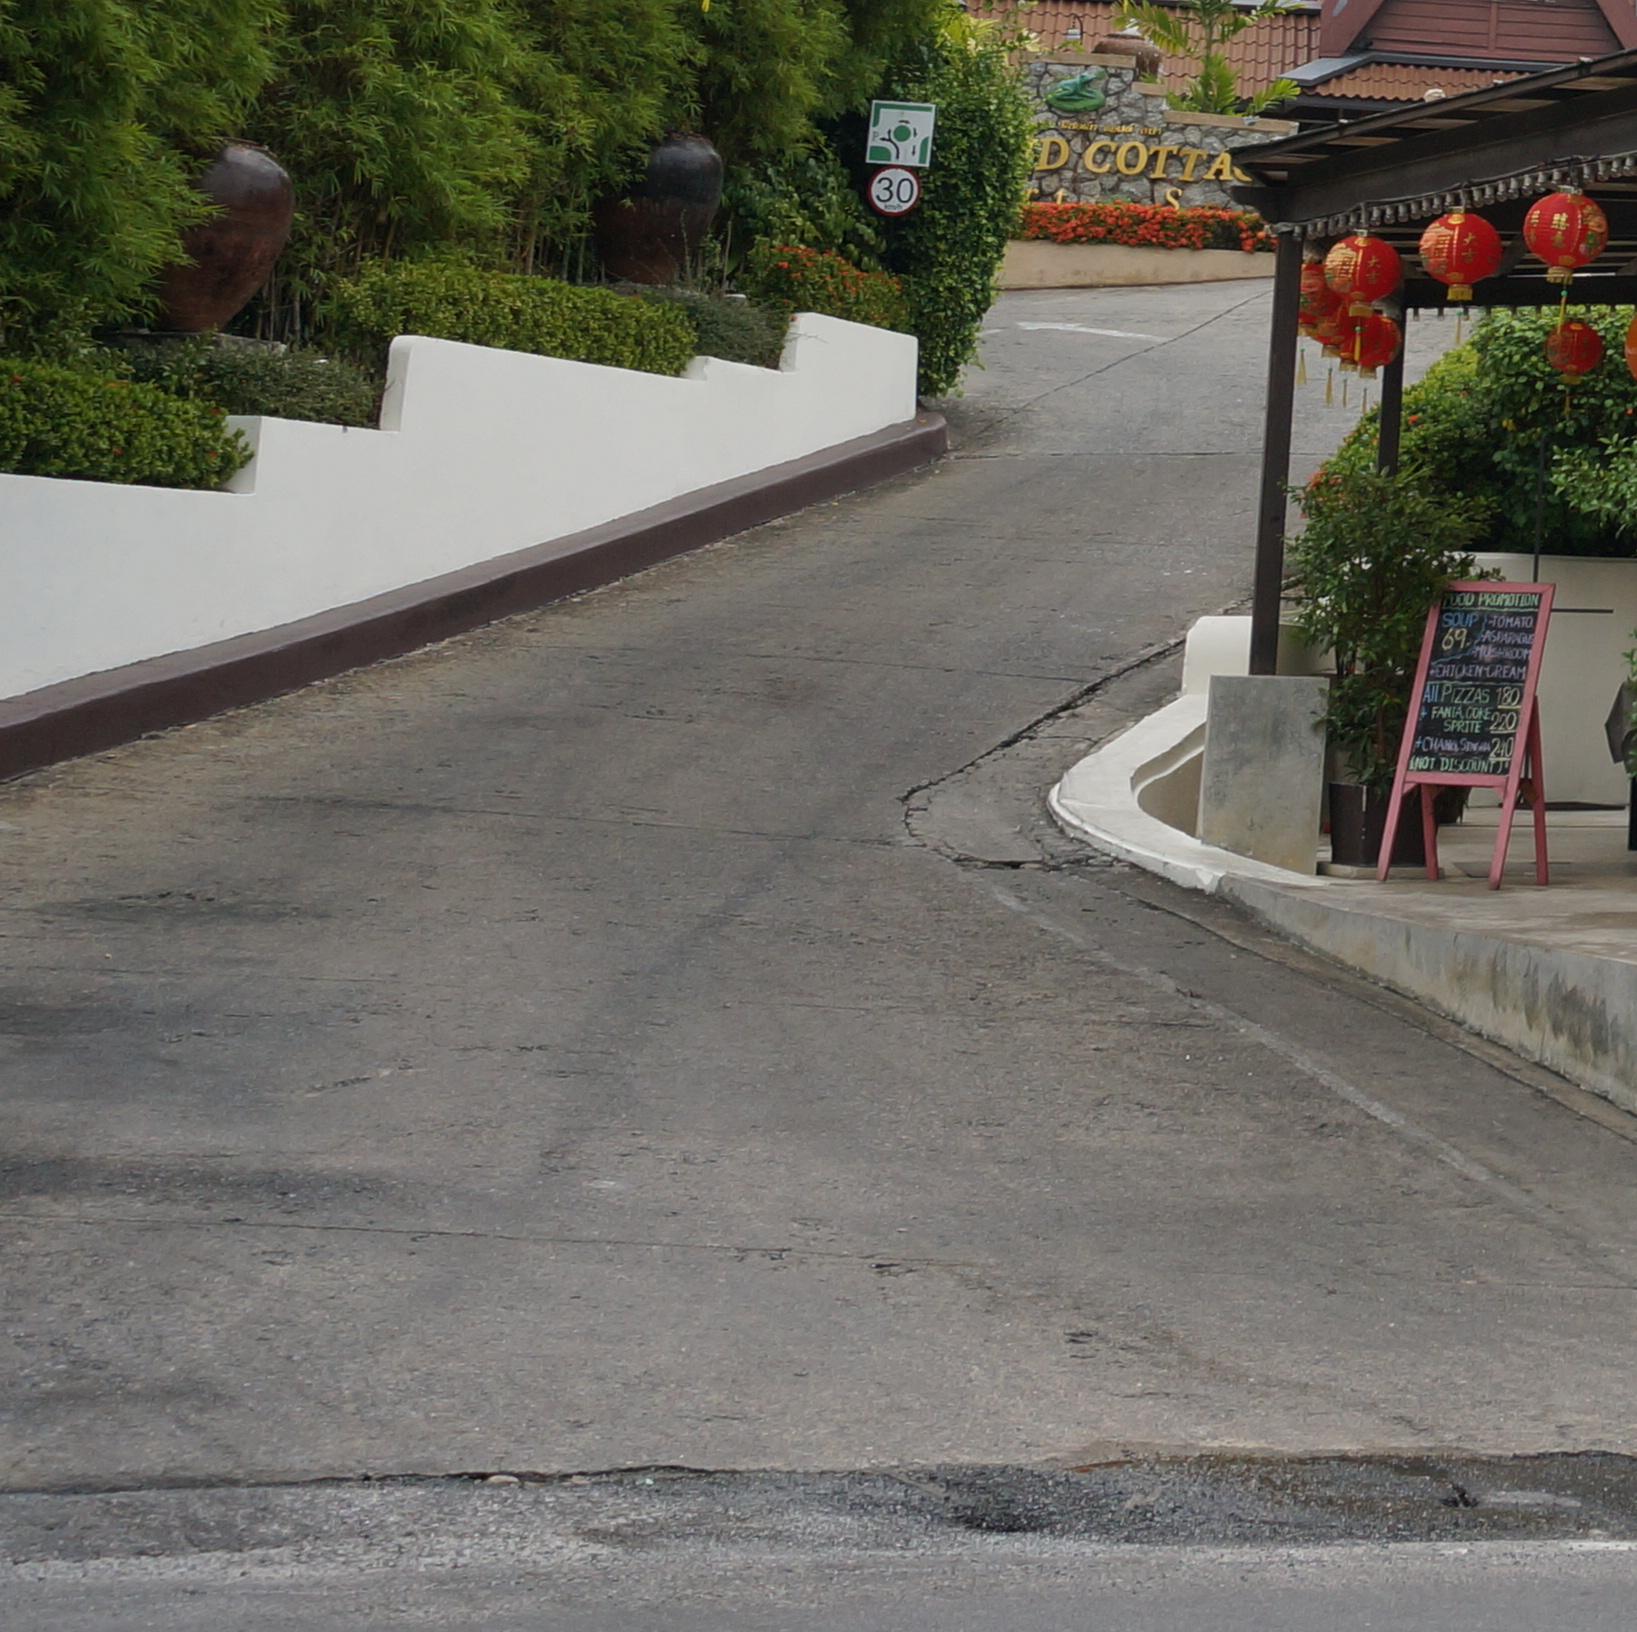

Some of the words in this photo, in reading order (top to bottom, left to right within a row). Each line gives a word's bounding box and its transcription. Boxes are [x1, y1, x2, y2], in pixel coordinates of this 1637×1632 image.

[1083, 141, 1253, 182] COTTA
[875, 176, 915, 204] 30
[1478, 593, 1540, 607] PROMOTION
[1441, 612, 1479, 628] SOUP
[1441, 683, 1491, 704] PIZZAS
[1496, 686, 1520, 706] 180
[1443, 718, 1484, 734] SPRITE
[1490, 710, 1518, 730] 220
